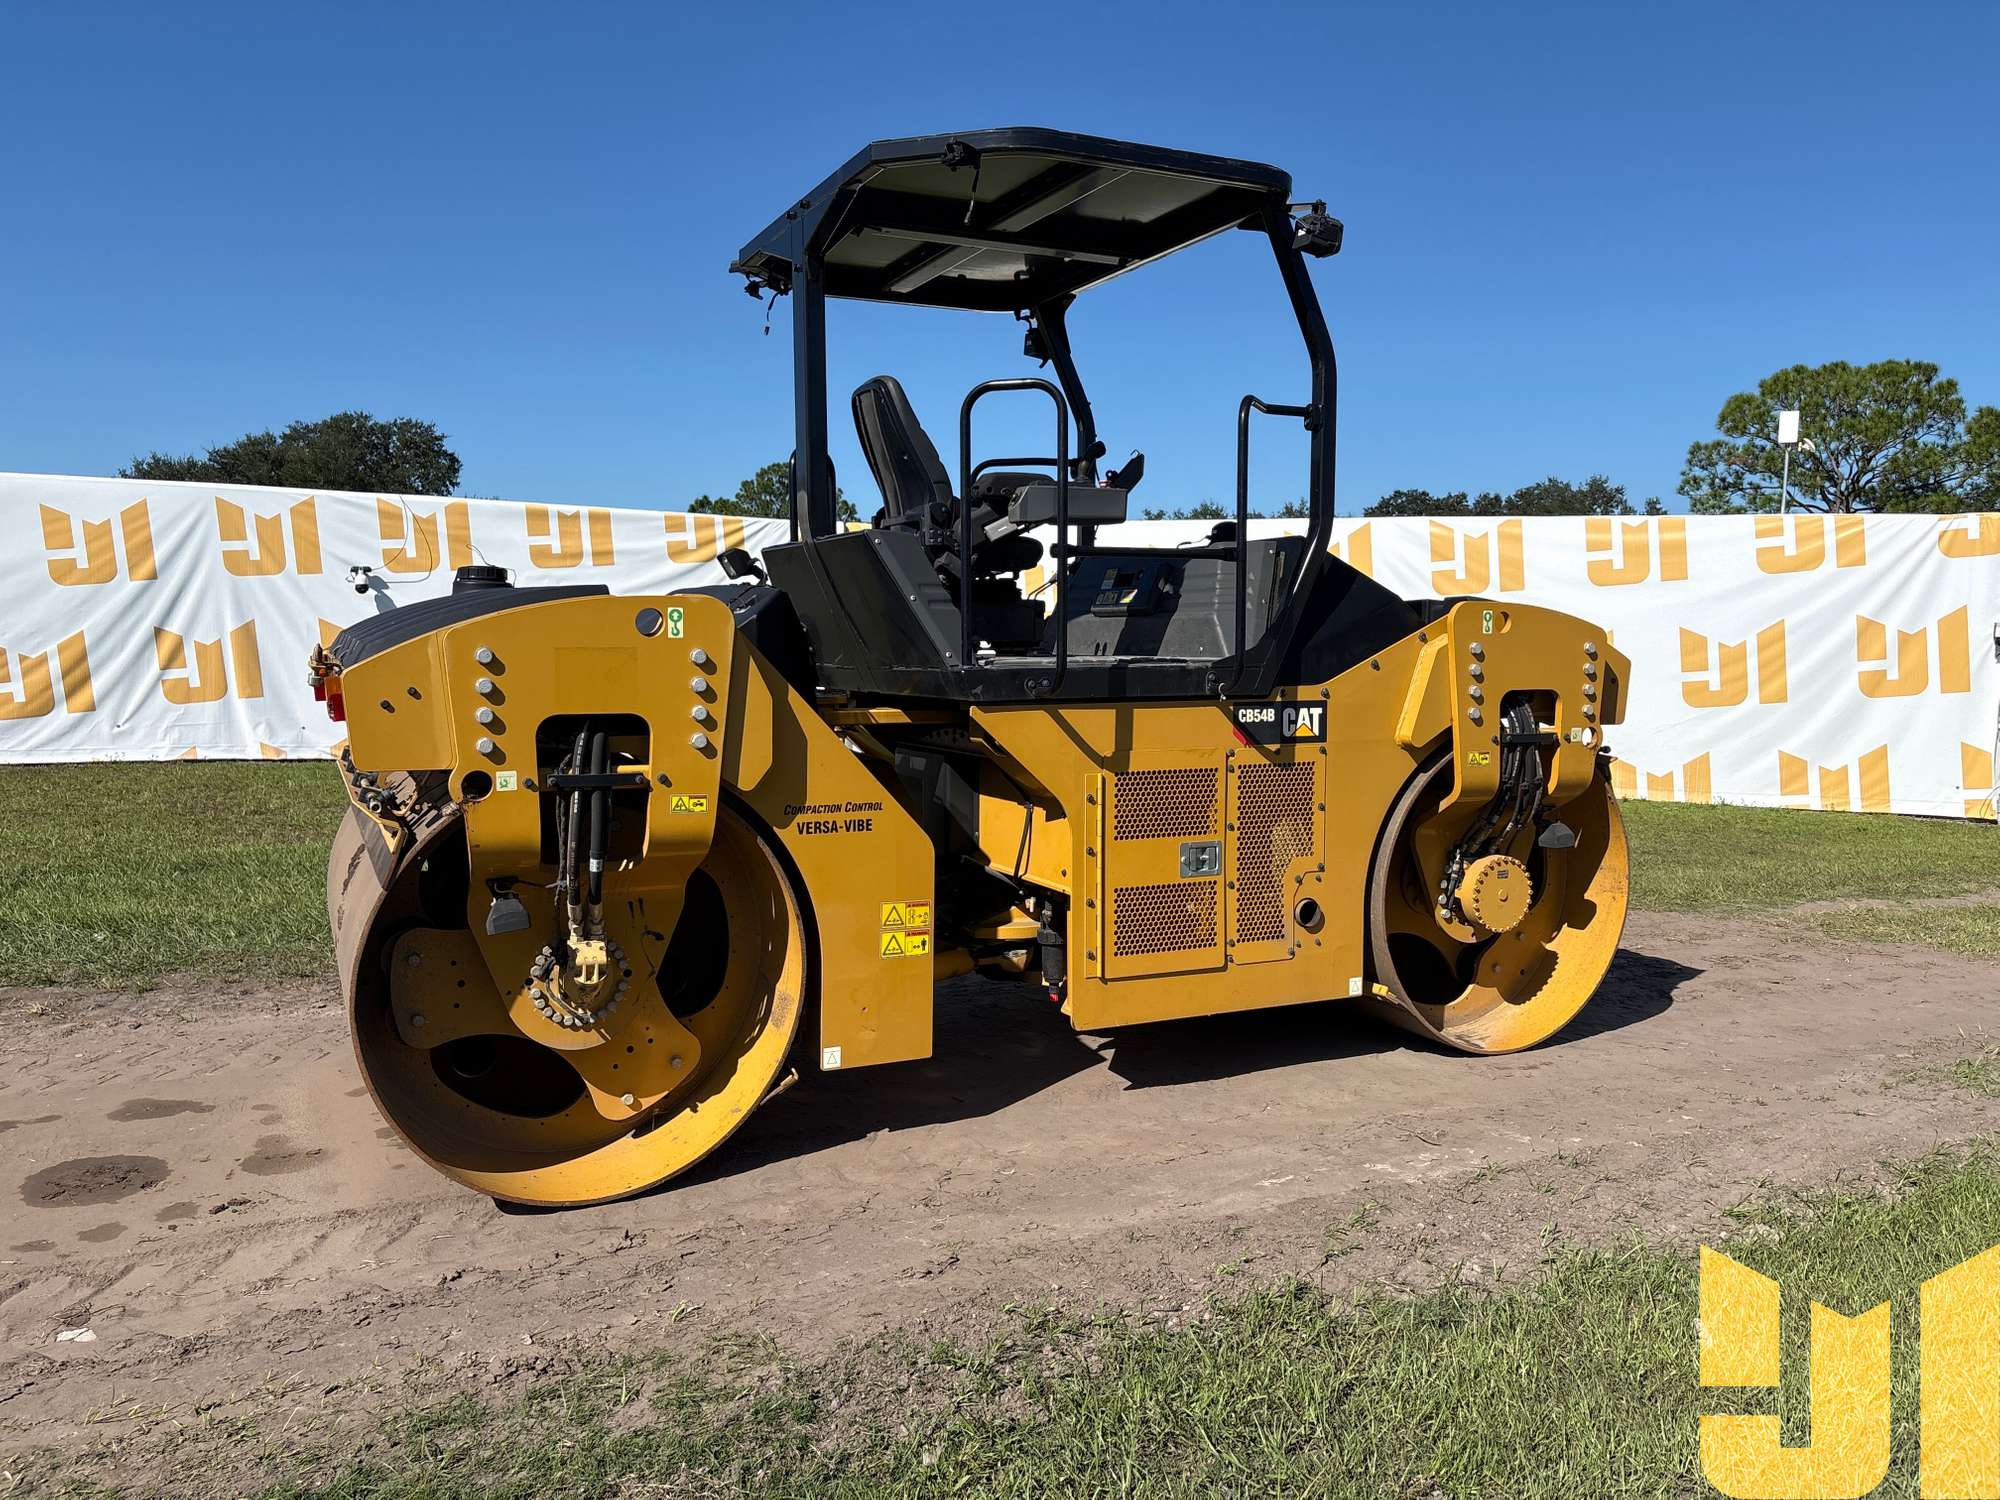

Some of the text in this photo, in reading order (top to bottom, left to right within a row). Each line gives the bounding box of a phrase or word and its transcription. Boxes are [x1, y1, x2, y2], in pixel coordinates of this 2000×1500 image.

[1238, 707, 1323, 737] CB54B CAT
[796, 818, 873, 835] VERSA-VIBE
